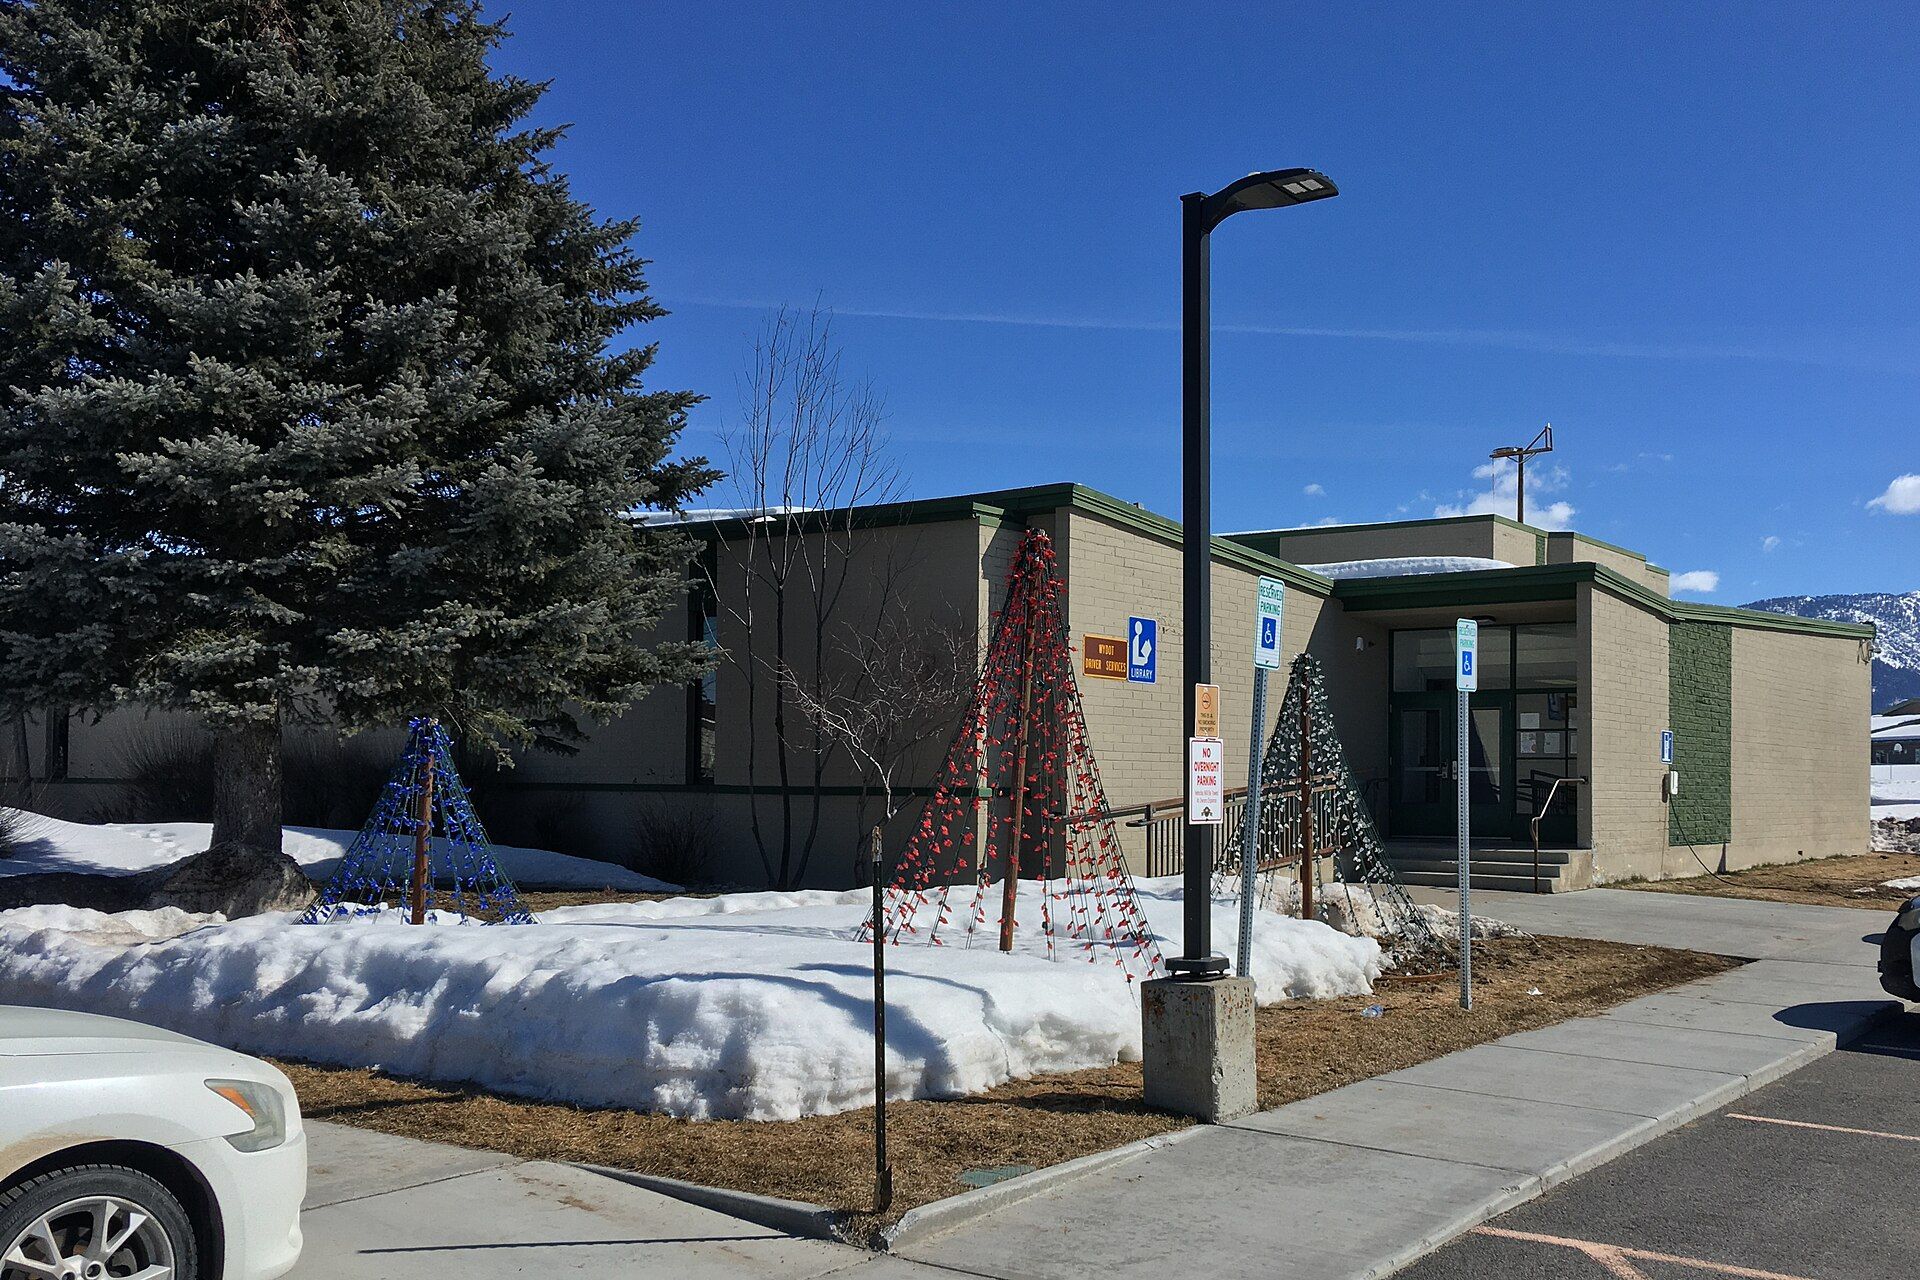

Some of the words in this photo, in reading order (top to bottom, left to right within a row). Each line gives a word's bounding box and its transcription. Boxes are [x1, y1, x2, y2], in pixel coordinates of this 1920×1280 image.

[1260, 585, 1283, 601] RESERVED
[1260, 601, 1280, 616] PARKING
[1085, 658, 1102, 670] DRIVER
[1106, 660, 1126, 673] SERVICES
[1130, 668, 1153, 680] LIBRARY
[1202, 747, 1212, 759] NO
[1194, 761, 1220, 772] OVERNIGHT
[1196, 775, 1217, 786] PARKING
